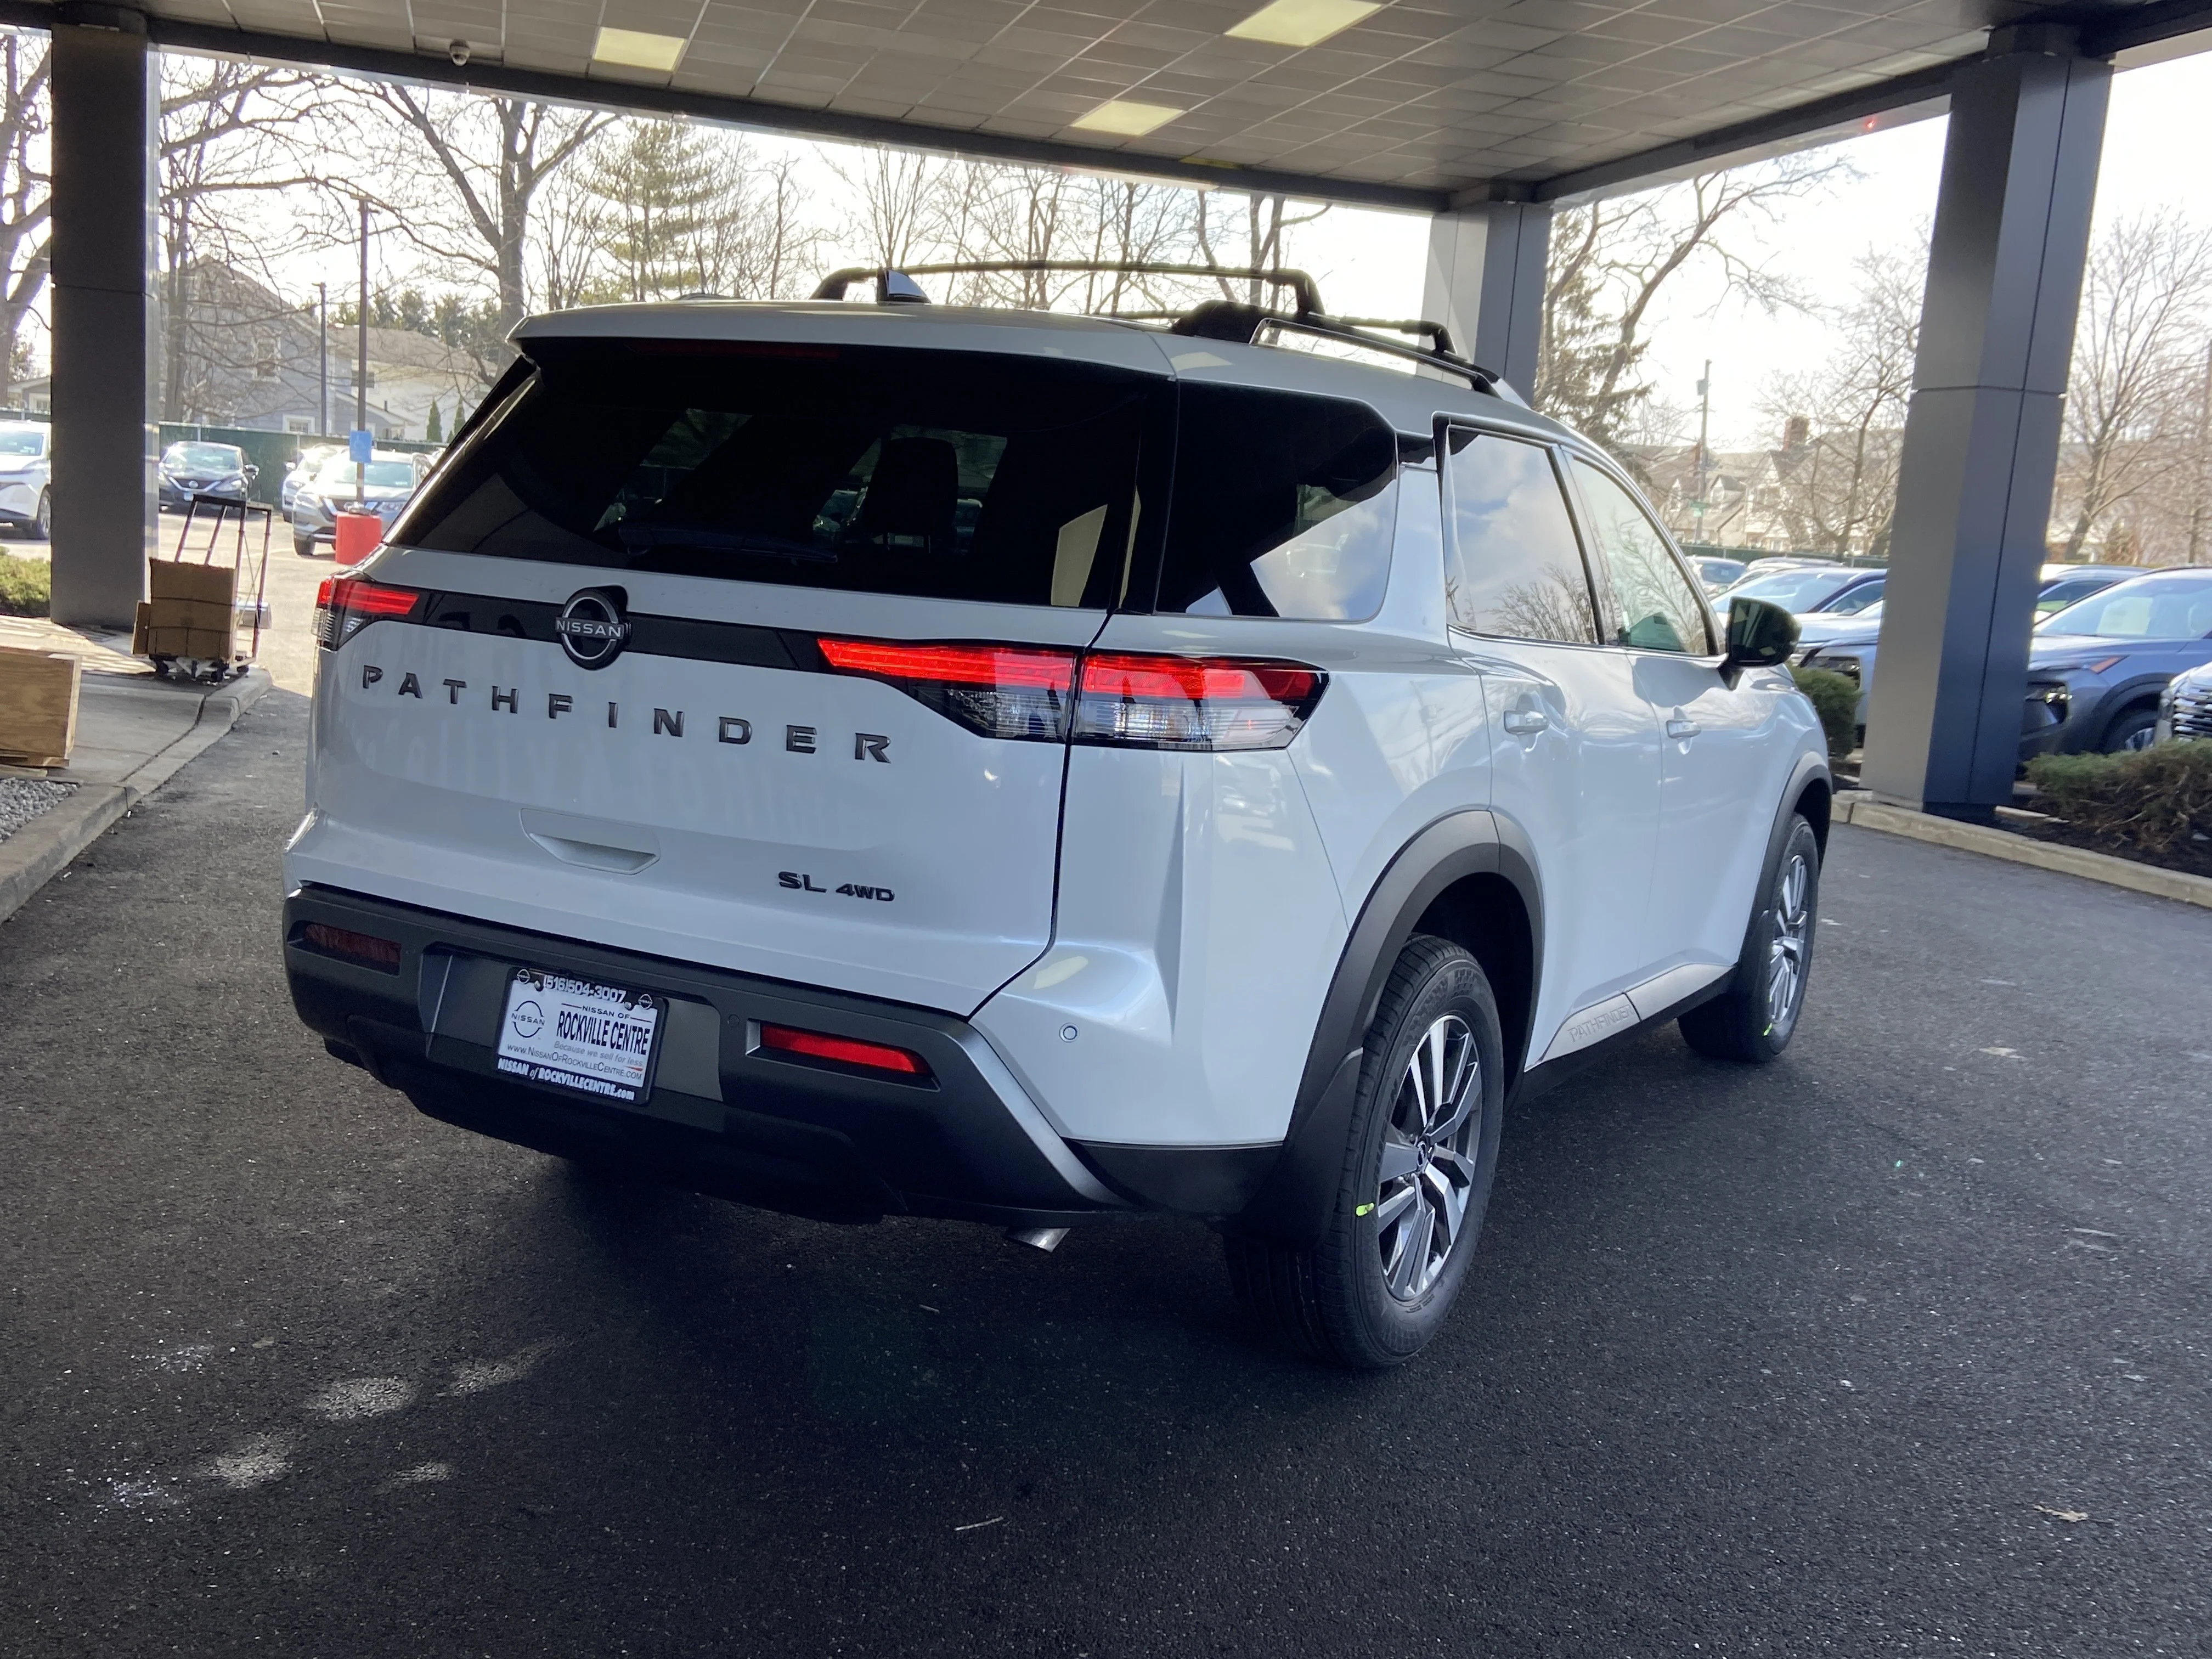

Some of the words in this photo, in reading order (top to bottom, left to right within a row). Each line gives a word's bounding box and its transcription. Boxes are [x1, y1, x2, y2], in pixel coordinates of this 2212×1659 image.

[556, 620, 621, 637] NISSAN
[362, 665, 891, 764] PATHFINDER
[778, 871, 827, 894] SL
[836, 883, 895, 902] 4WD
[511, 1013, 545, 1025] NISSAN
[582, 1005, 615, 1017] NISSAN
[1567, 1004, 1635, 1043] PATHFINDER
[556, 1011, 610, 1047] ROCKVILLE
[610, 1021, 651, 1056] CENTRE
[554, 1041, 585, 1054] Because
[600, 1052, 613, 1060] sell
[614, 1054, 626, 1064] for
[498, 1058, 529, 1076] NISSAN
[529, 1068, 539, 1080] of
[538, 1067, 635, 1101] ROCKVILLECENTRE.com
